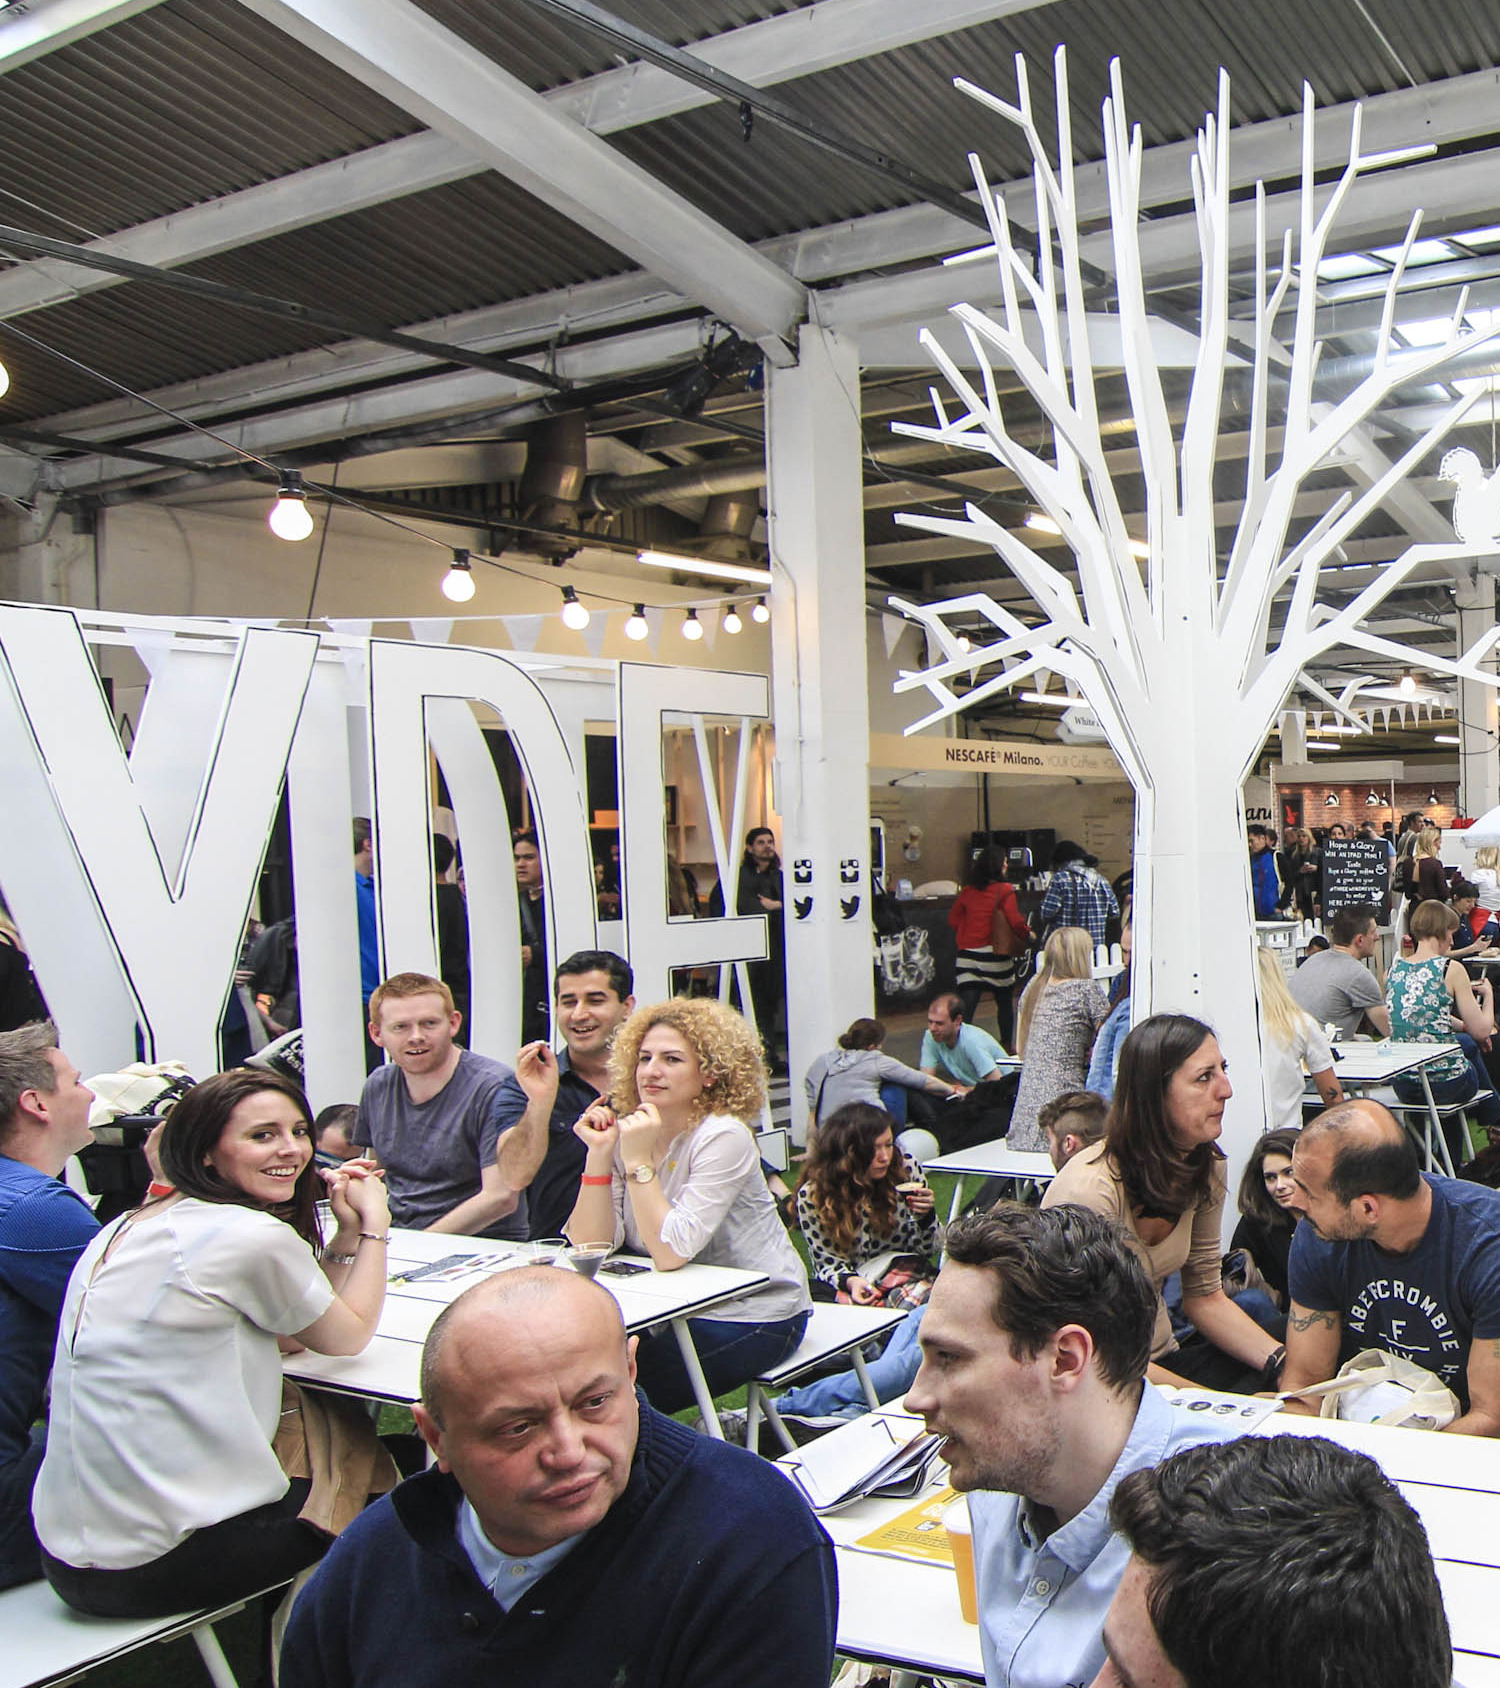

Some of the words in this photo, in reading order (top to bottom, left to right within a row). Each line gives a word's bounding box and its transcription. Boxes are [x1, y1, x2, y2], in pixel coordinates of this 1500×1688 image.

[1003, 751, 1044, 766] Milano.
[1329, 840, 1347, 850] Hope
[1356, 841, 1375, 852] Glory
